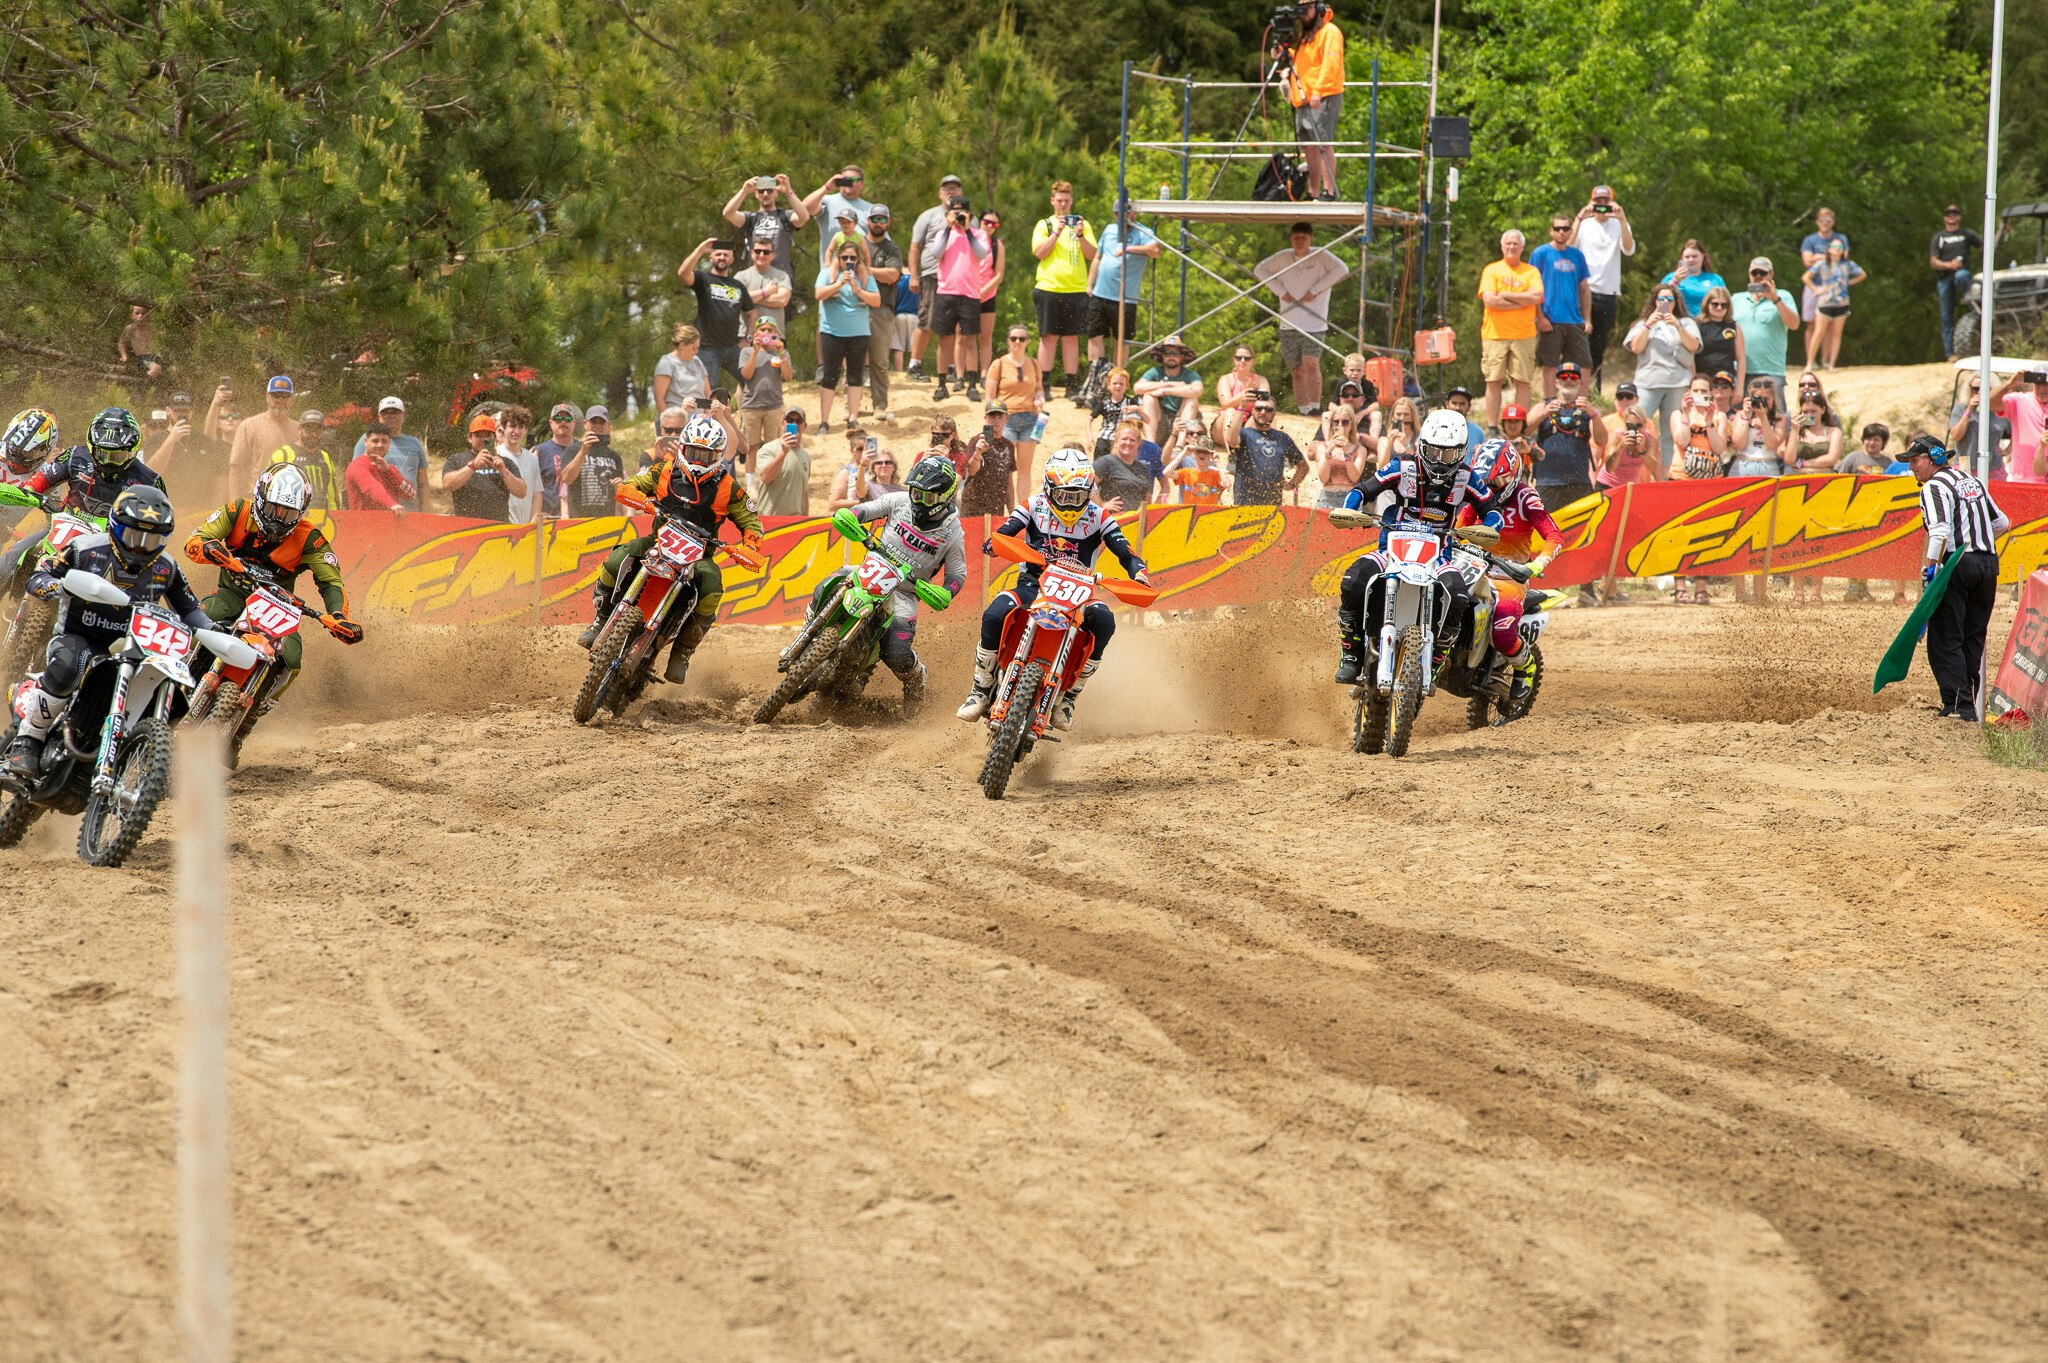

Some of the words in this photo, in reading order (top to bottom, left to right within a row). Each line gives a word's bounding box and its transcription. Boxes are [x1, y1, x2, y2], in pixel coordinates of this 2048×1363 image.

[894, 524, 908, 538] FLY
[906, 533, 939, 556] RACING
[1634, 476, 1922, 577] FMF
[660, 528, 703, 564] 514
[1404, 540, 1426, 562] 1
[380, 516, 628, 620] FMF
[858, 560, 900, 597] 314
[1043, 575, 1092, 606] 530
[247, 598, 299, 635] 407
[138, 617, 189, 658] 342
